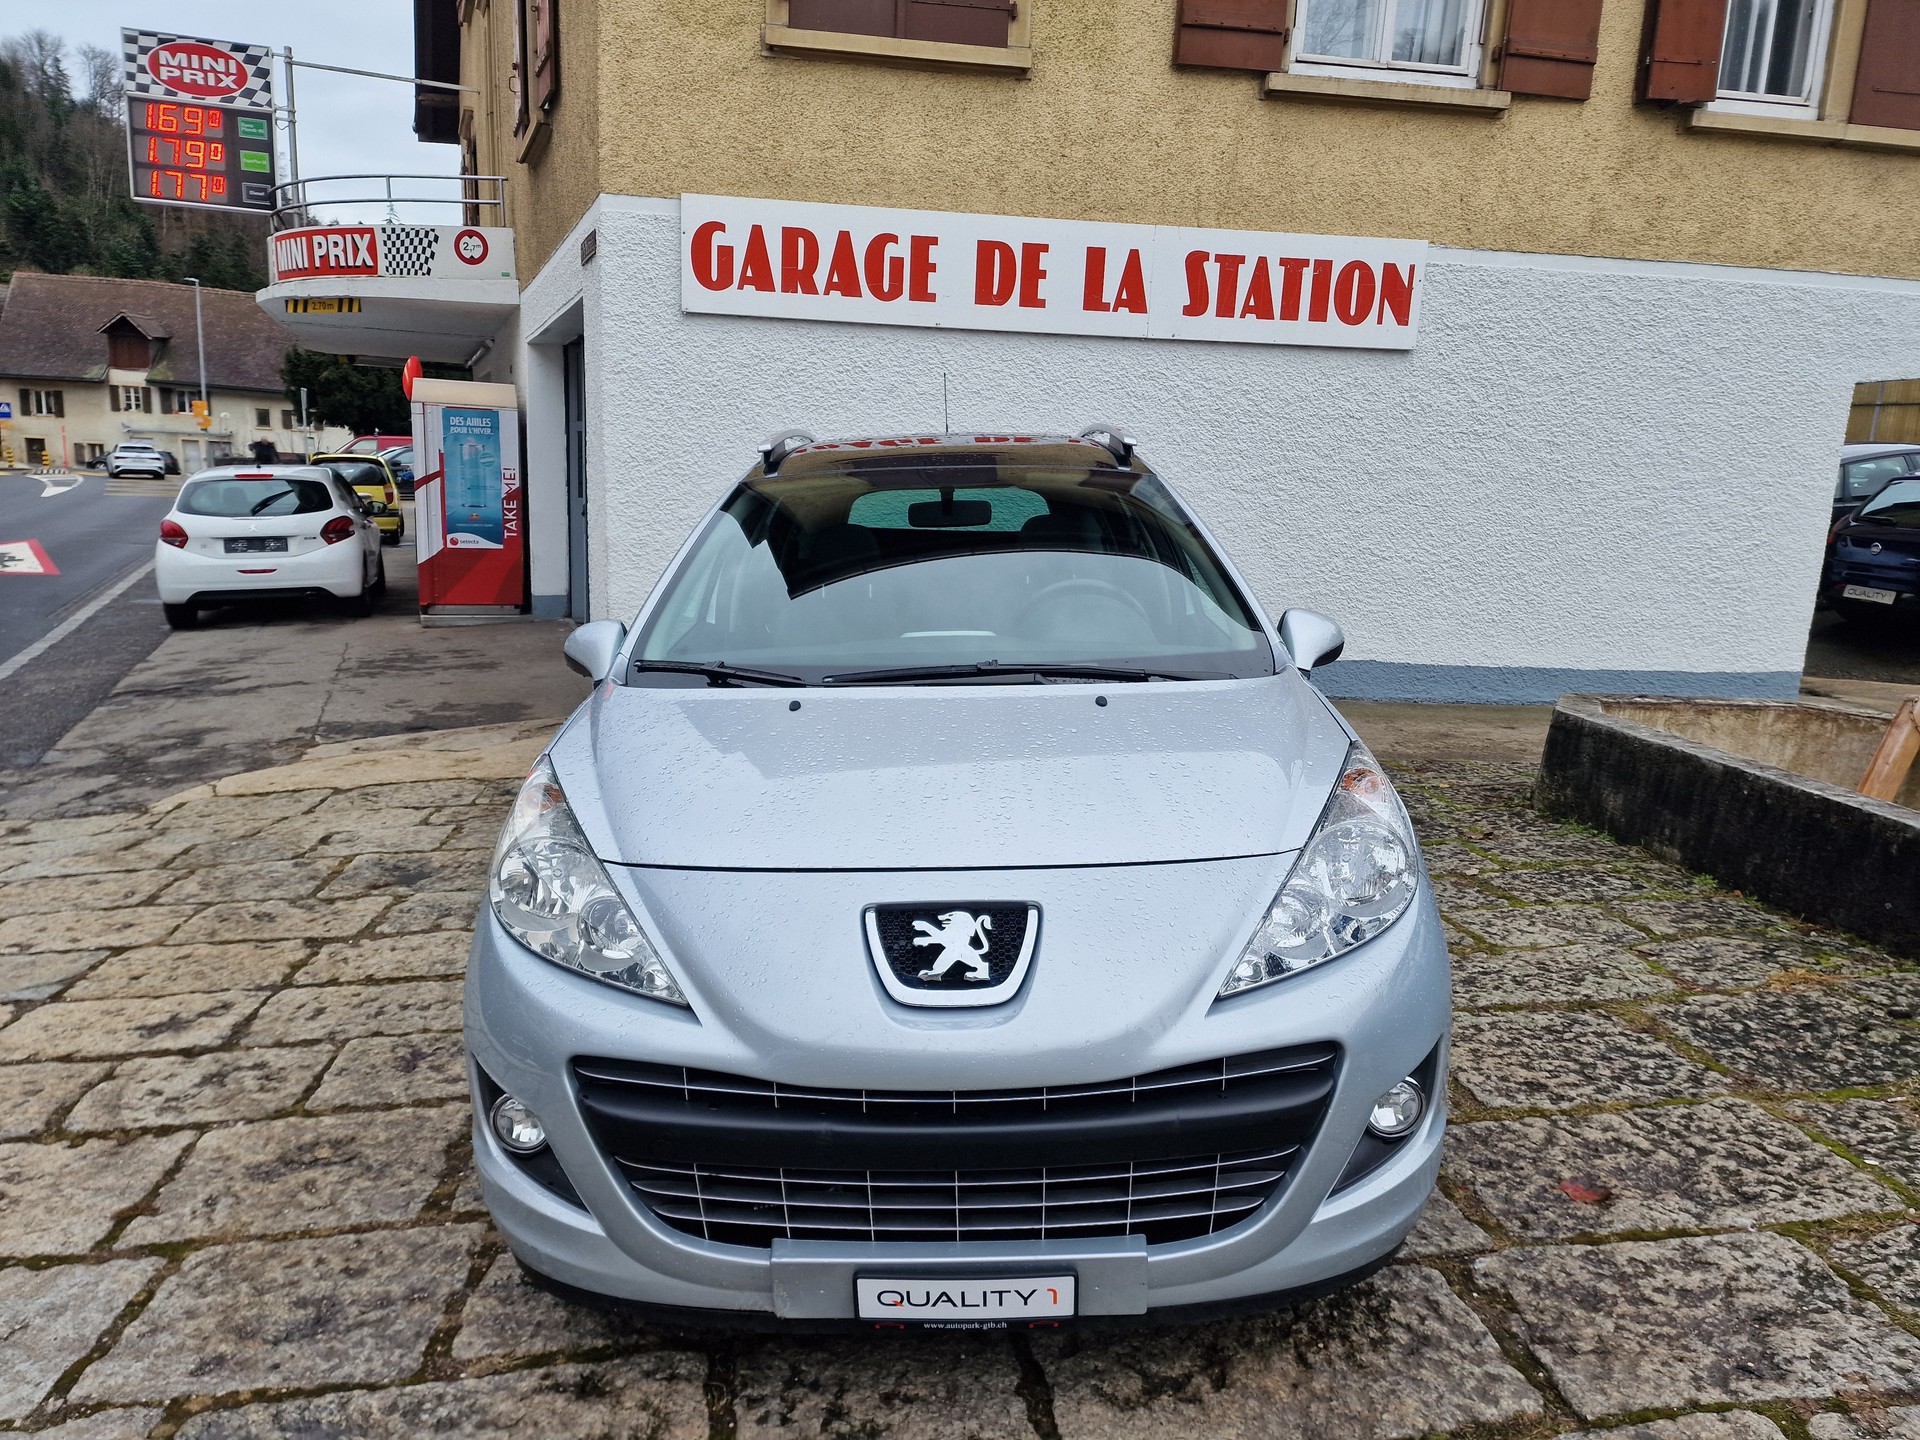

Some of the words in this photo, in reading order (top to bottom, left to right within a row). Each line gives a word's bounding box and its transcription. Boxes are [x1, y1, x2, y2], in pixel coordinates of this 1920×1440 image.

[158, 50, 237, 74] MINI
[159, 66, 239, 89] PRIX
[276, 235, 309, 273] MINI
[312, 233, 374, 269] PRIX
[690, 220, 939, 303] GARAGE
[974, 238, 1049, 309] DE
[1082, 246, 1149, 315] LA
[1181, 249, 1416, 327] STATION
[450, 416, 464, 426] DES
[451, 426, 468, 434] POUR
[502, 467, 516, 496] ME!
[503, 500, 517, 539] TAKE
[876, 1289, 1038, 1308] QUALITY
[1046, 1288, 1059, 1305] 1
[923, 1321, 1007, 1331] www.autopark-gtb.ch
